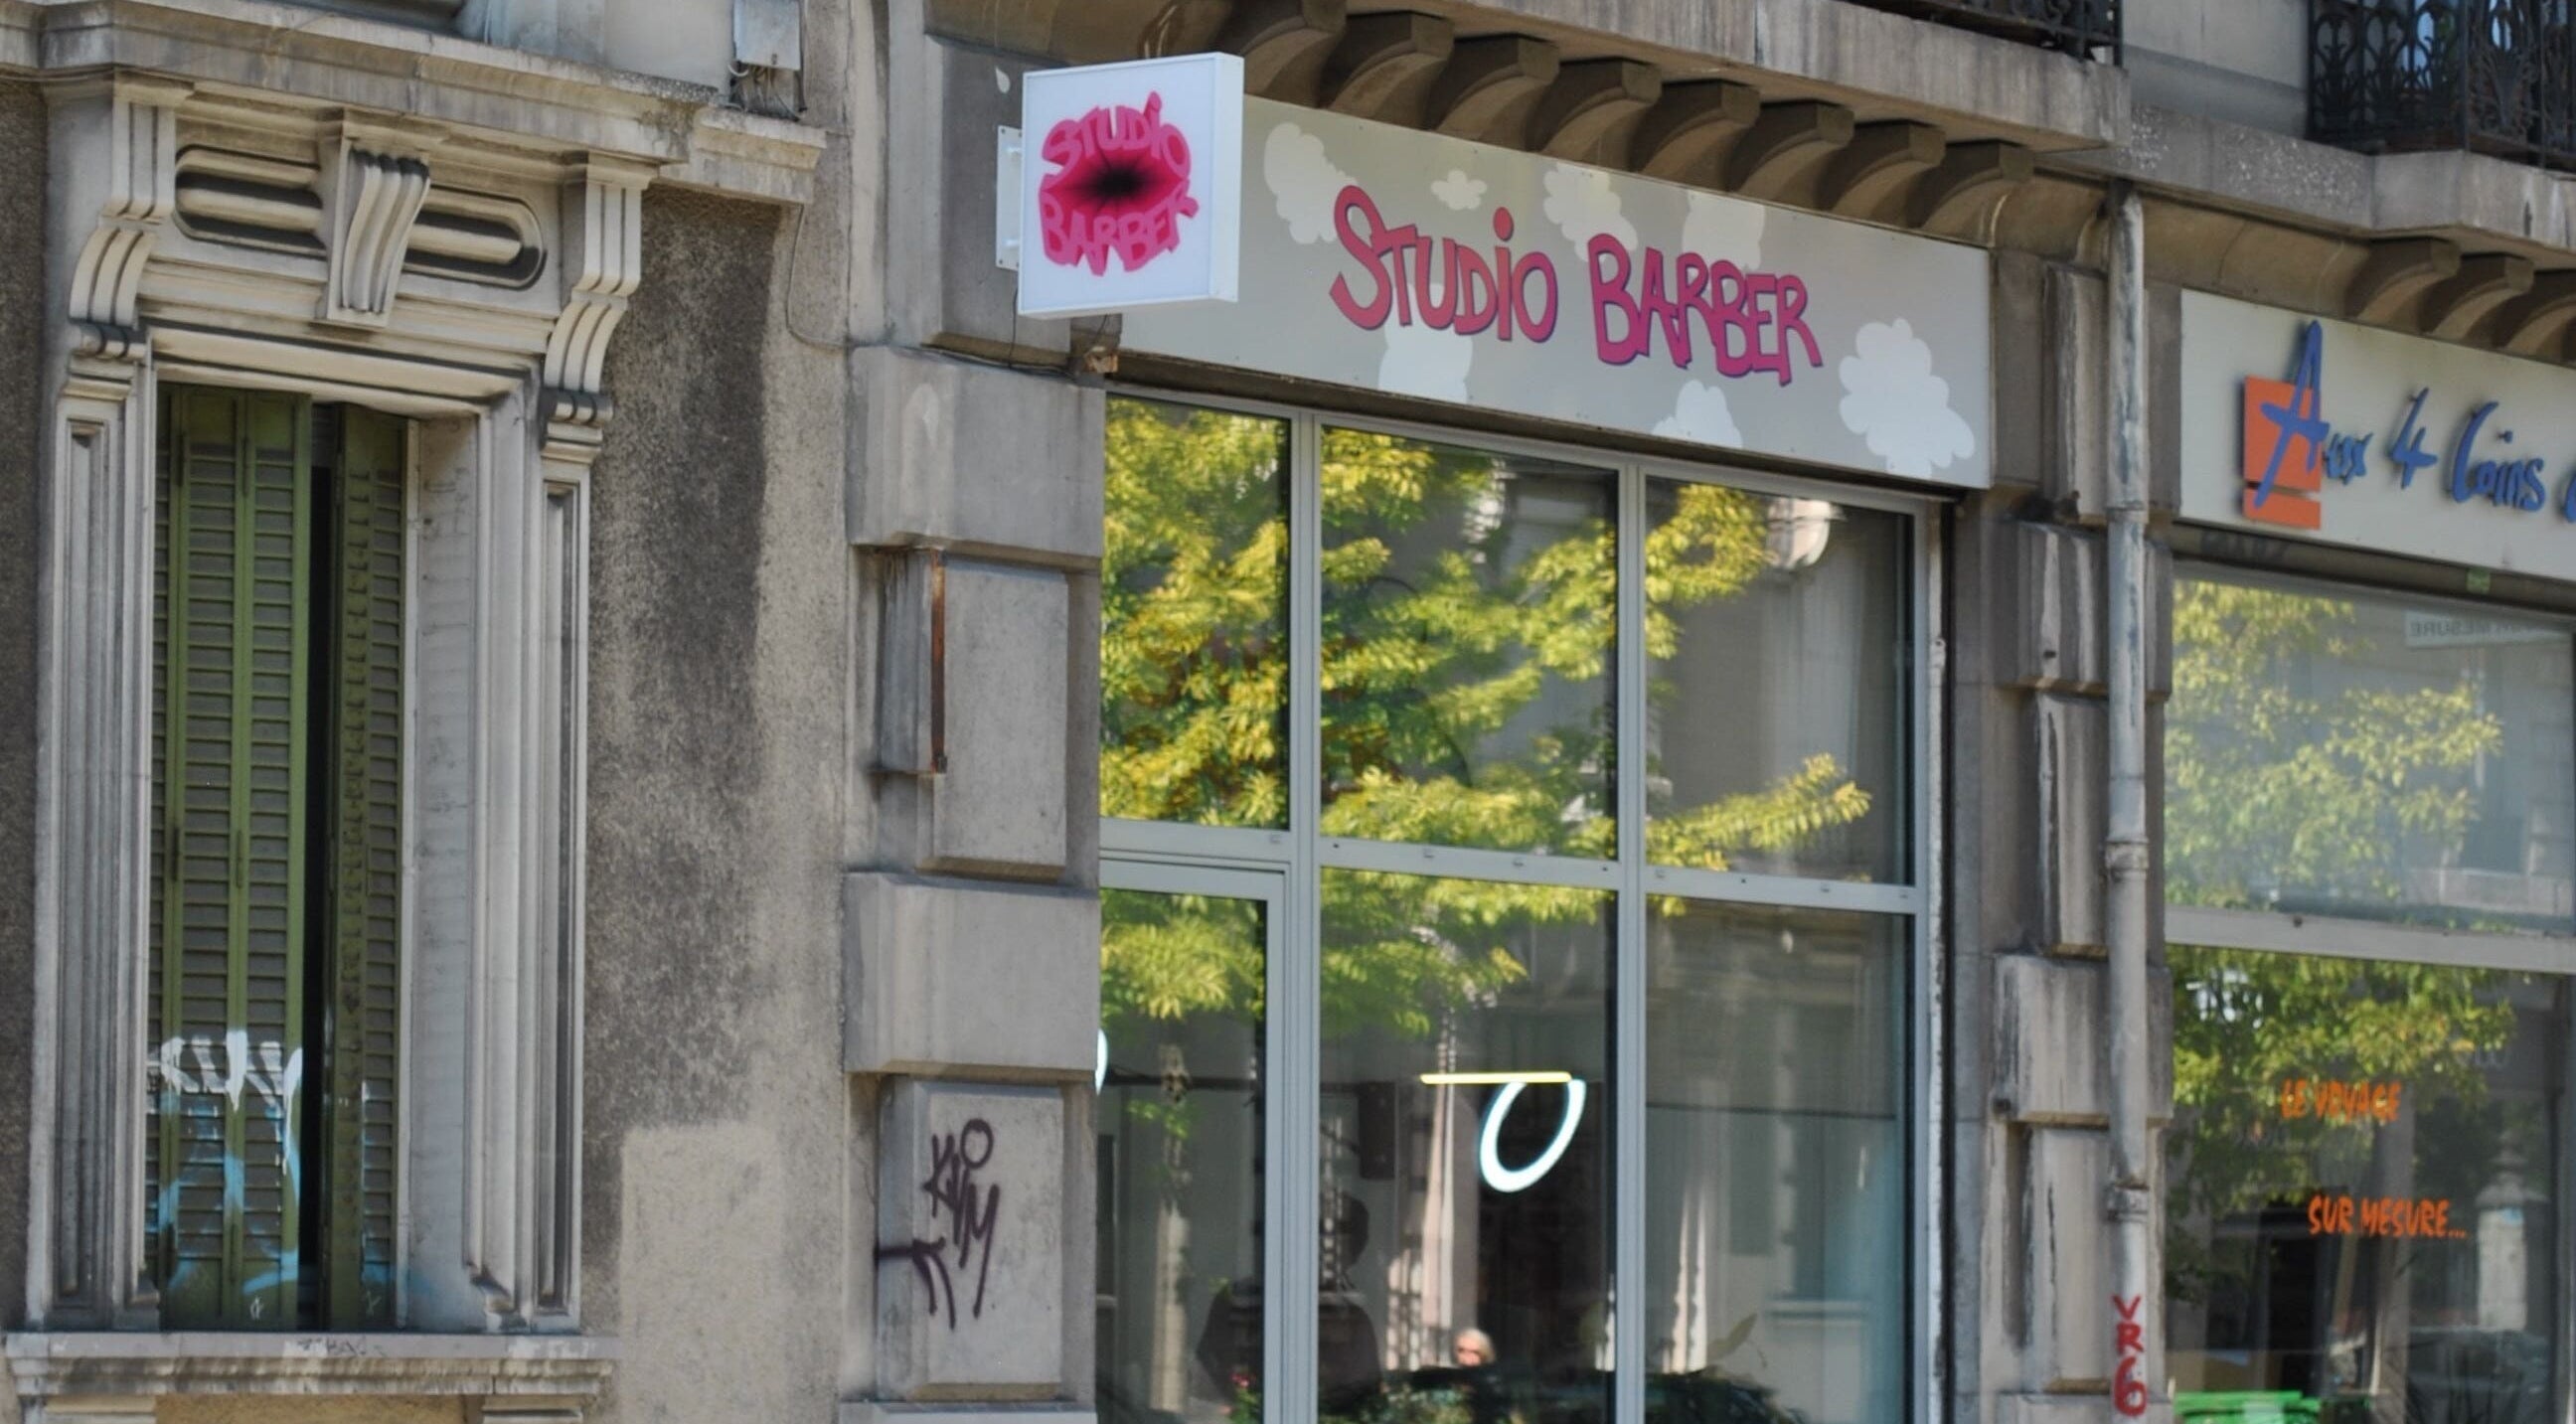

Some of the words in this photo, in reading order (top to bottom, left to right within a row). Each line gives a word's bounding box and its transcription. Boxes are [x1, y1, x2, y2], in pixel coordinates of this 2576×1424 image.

[1039, 178, 1199, 276] BARBER
[1588, 233, 1823, 387] BARBER
[2253, 320, 2373, 509] Aux
[2390, 387, 2438, 489] 4
[2449, 401, 2546, 512] Coins
[2282, 1077, 2308, 1119] LE
[2315, 1077, 2401, 1123] VOYAGE
[2309, 1194, 2353, 1234] SUR
